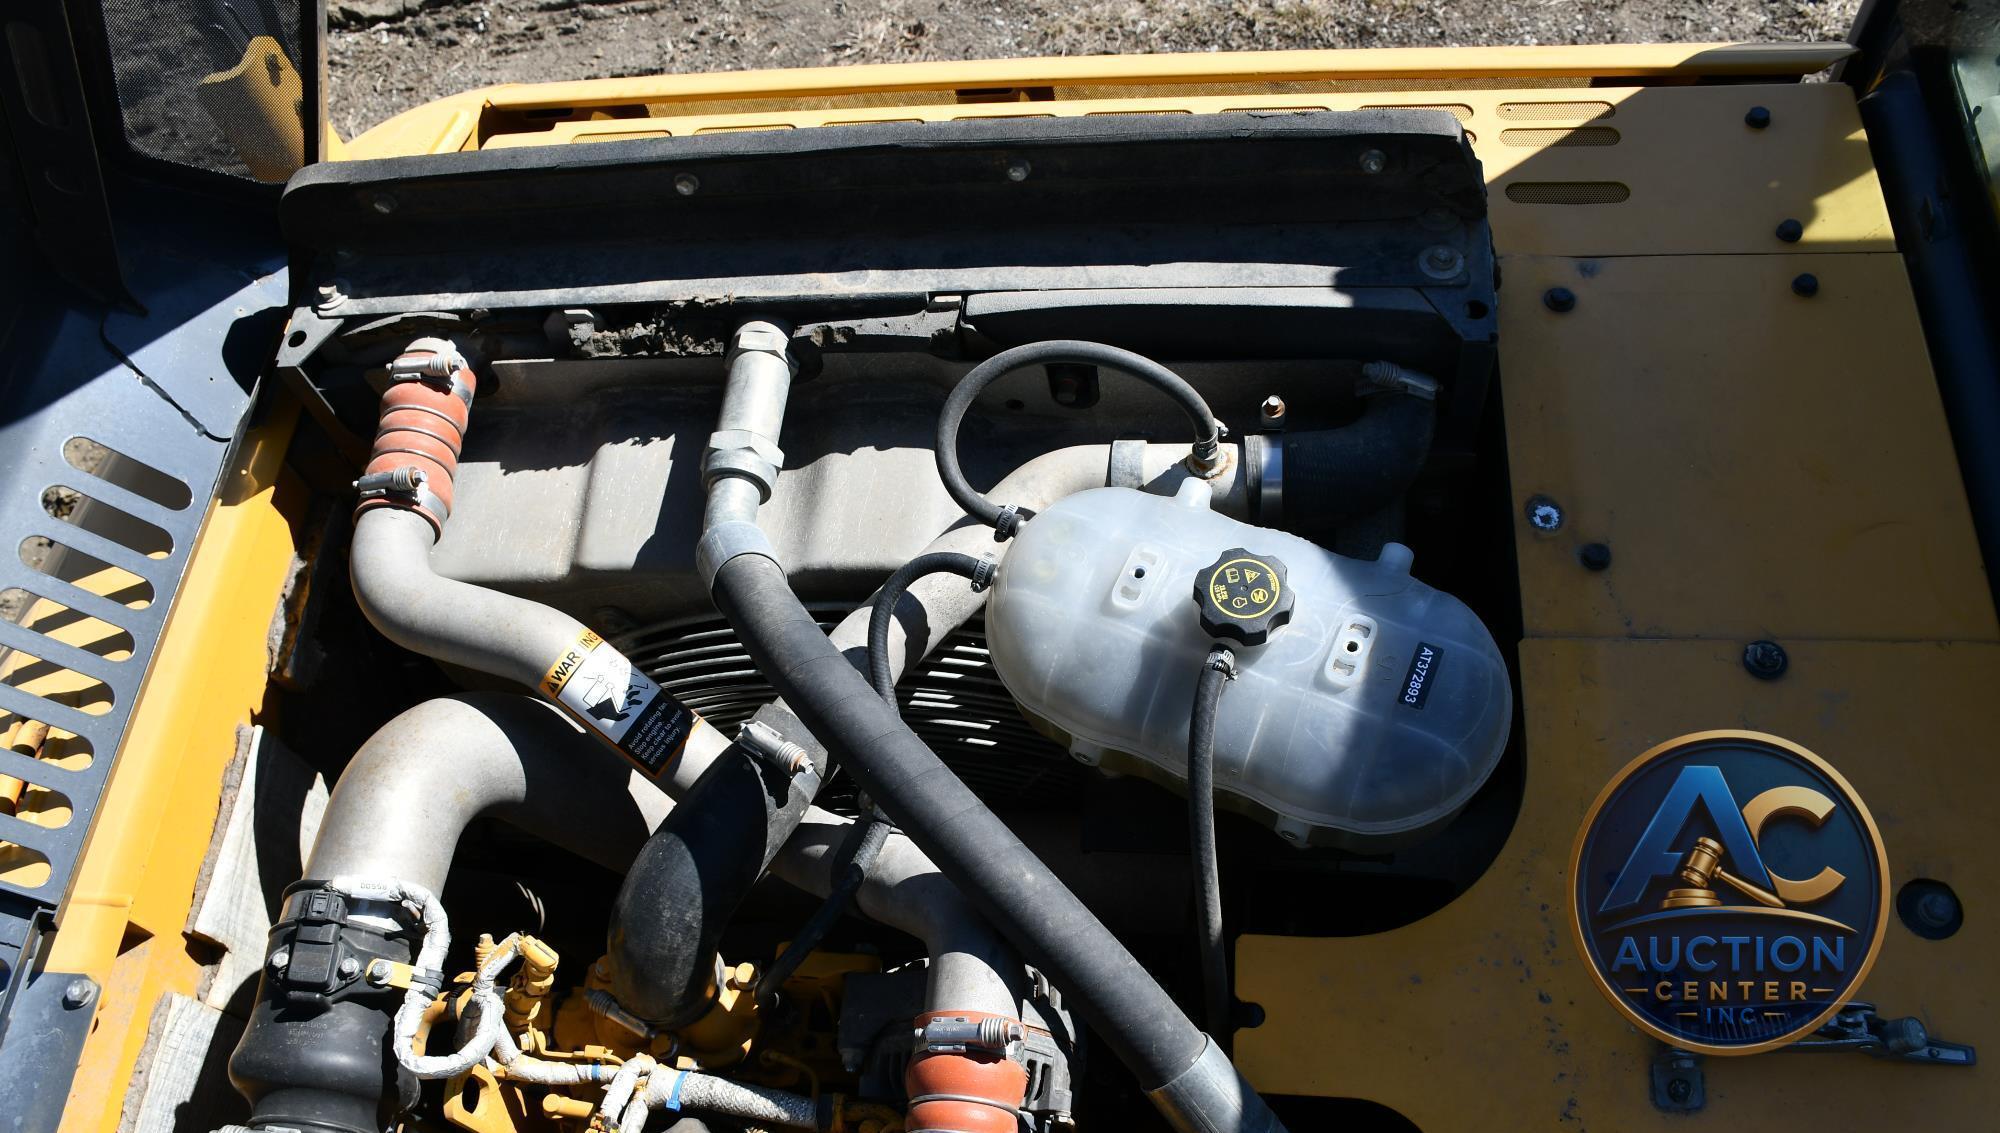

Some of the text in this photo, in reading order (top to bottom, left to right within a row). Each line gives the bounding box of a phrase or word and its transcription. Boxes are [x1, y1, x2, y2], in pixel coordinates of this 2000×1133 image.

[1405, 646, 1434, 703] AT372893
[628, 733, 642, 750] Avoid
[641, 710, 662, 734] rotating
[634, 741, 647, 755] Stop
[641, 745, 655, 760] Keep
[653, 730, 666, 746] clear
[670, 708, 683, 724] avoid
[648, 727, 681, 765] serious injury.
